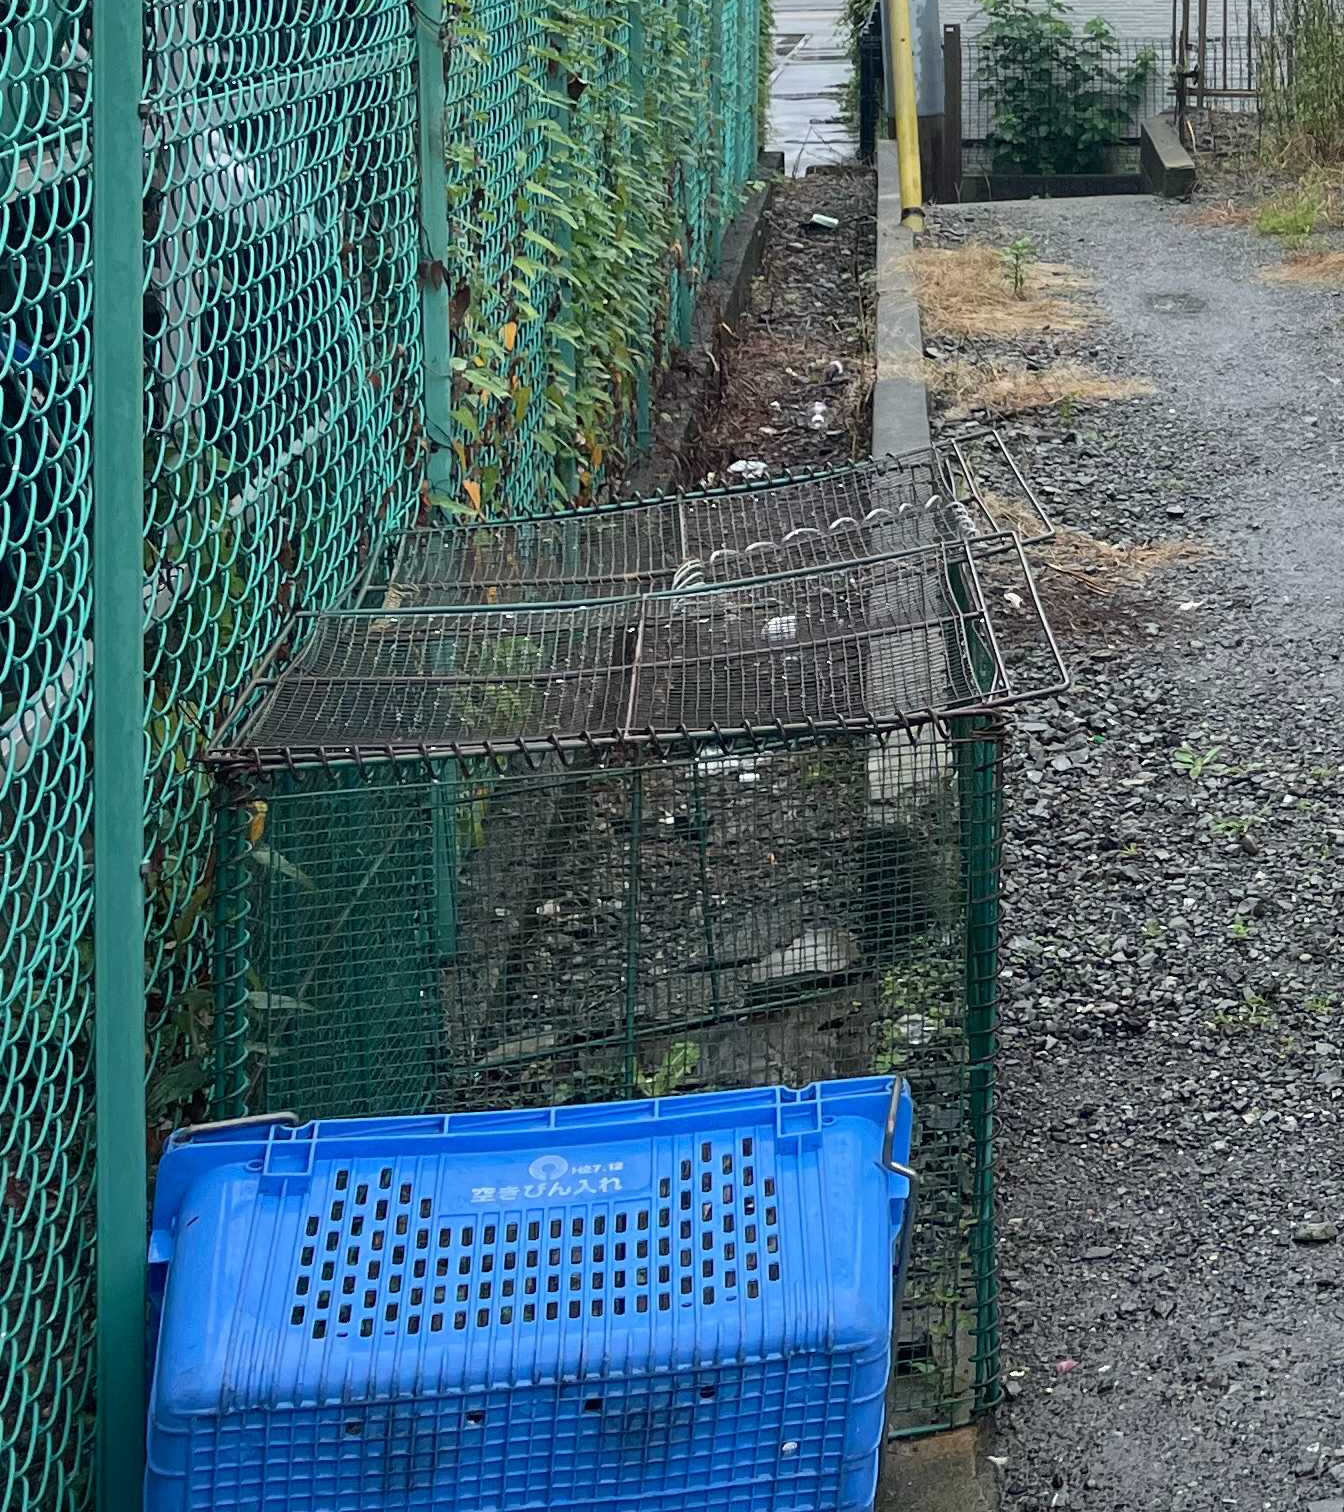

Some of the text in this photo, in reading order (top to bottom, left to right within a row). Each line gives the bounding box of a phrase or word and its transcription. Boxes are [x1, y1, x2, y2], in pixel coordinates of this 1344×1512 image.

[470, 1176, 623, 1203] 空きびん入れ
